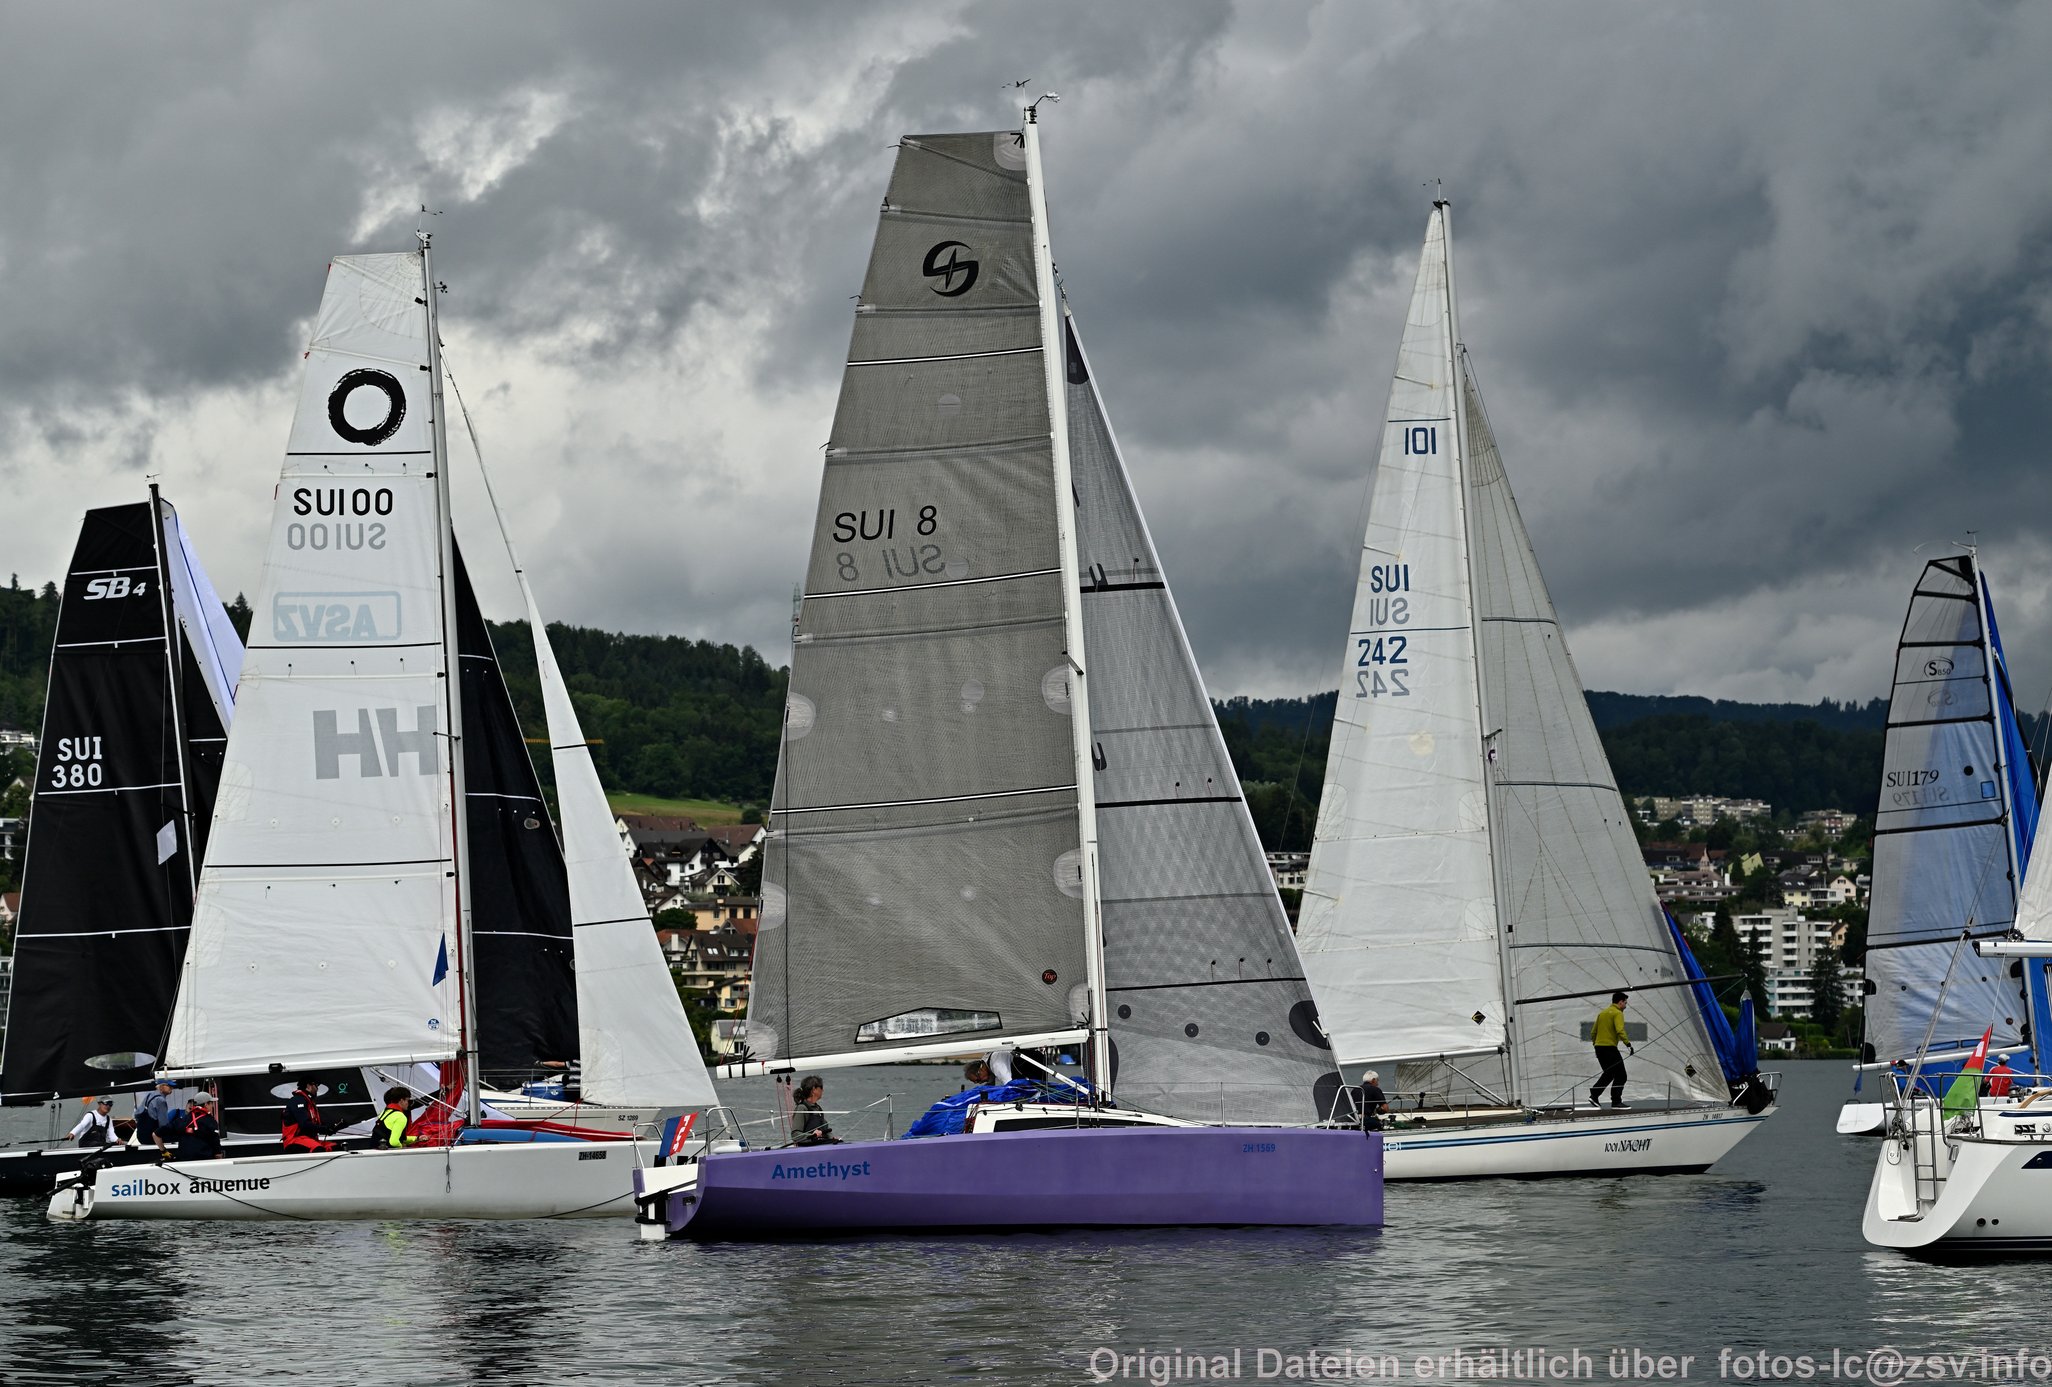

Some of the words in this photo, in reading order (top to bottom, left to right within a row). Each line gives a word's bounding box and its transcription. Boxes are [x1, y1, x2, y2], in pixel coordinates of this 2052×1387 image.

[1404, 427, 1437, 455] 101
[833, 509, 895, 543] SUI
[917, 505, 937, 536] 8
[1370, 564, 1410, 593] SUI
[1357, 636, 1408, 667] 242
[57, 736, 102, 761] SUI
[51, 763, 102, 788] 380
[771, 1161, 871, 1181] Amethyst
[111, 1179, 181, 1197] sailbox
